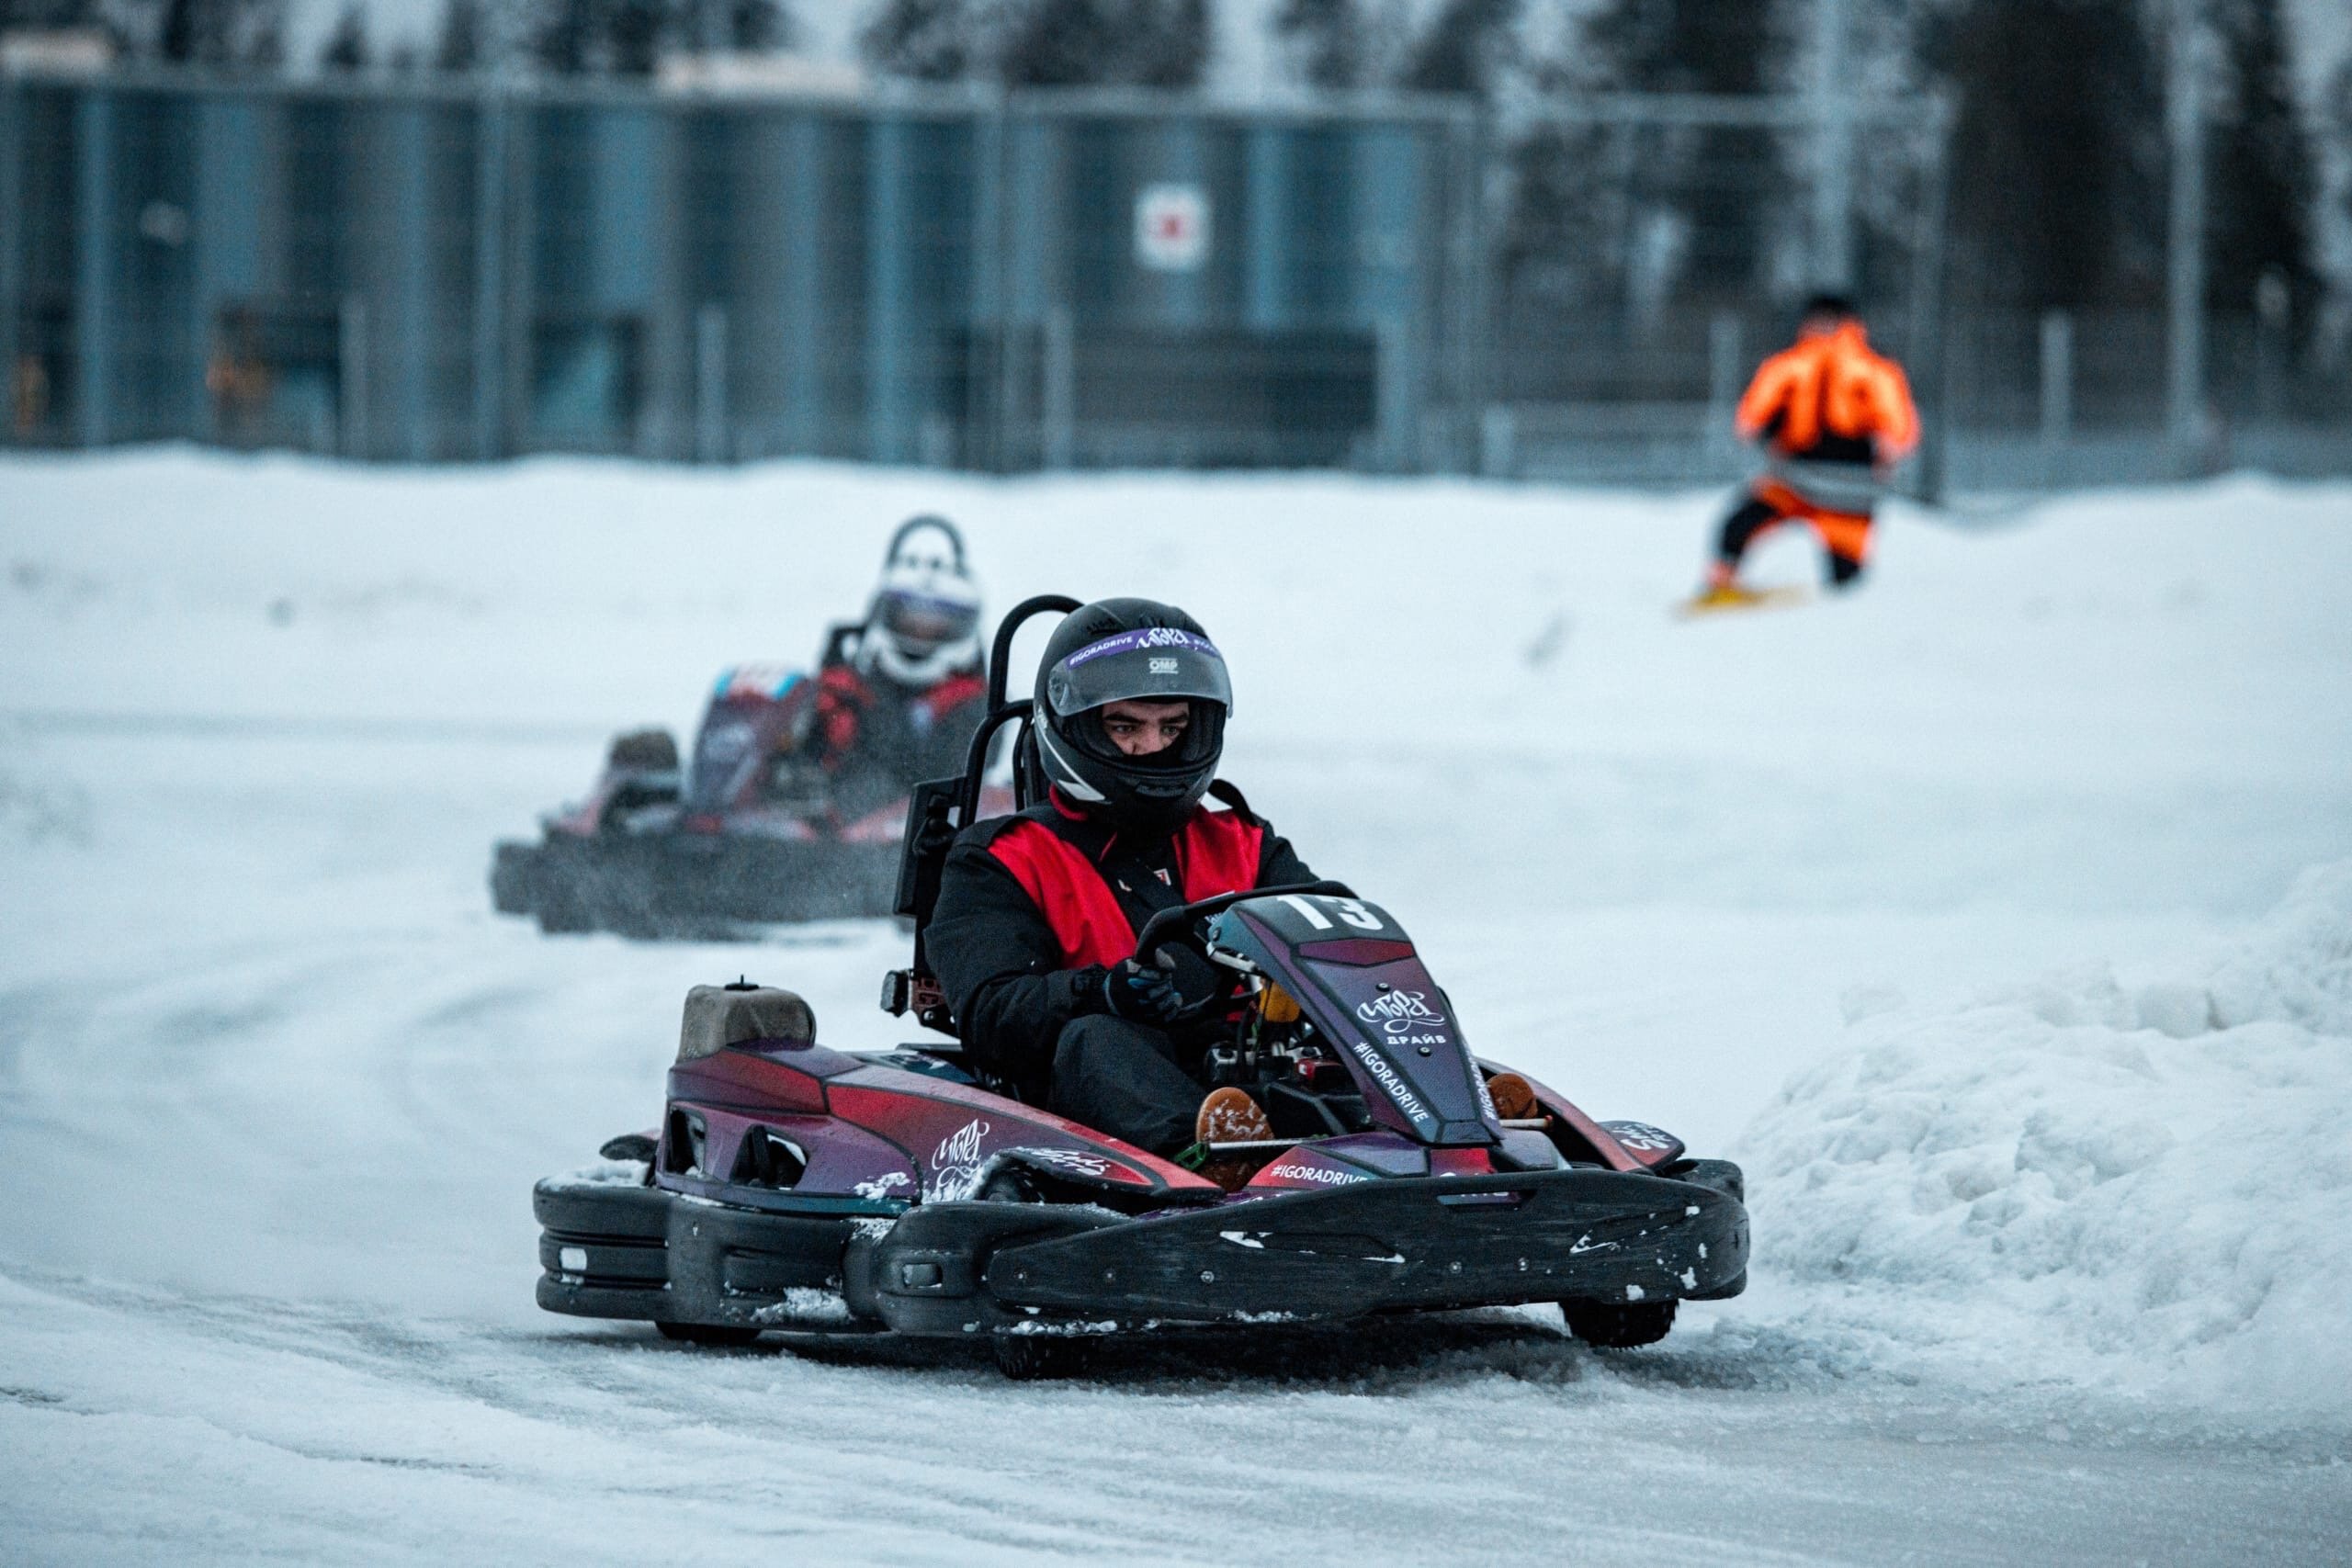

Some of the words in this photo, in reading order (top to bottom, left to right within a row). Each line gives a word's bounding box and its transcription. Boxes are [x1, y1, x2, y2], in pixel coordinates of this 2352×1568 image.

[1148, 660, 1179, 671] OMP
[1276, 895, 1384, 931] 13
[1386, 1033, 1447, 1044] ДРАЙВ
[1353, 1042, 1430, 1122] #IGORADRIVE
[1271, 1164, 1368, 1185] #IGORADRIV
